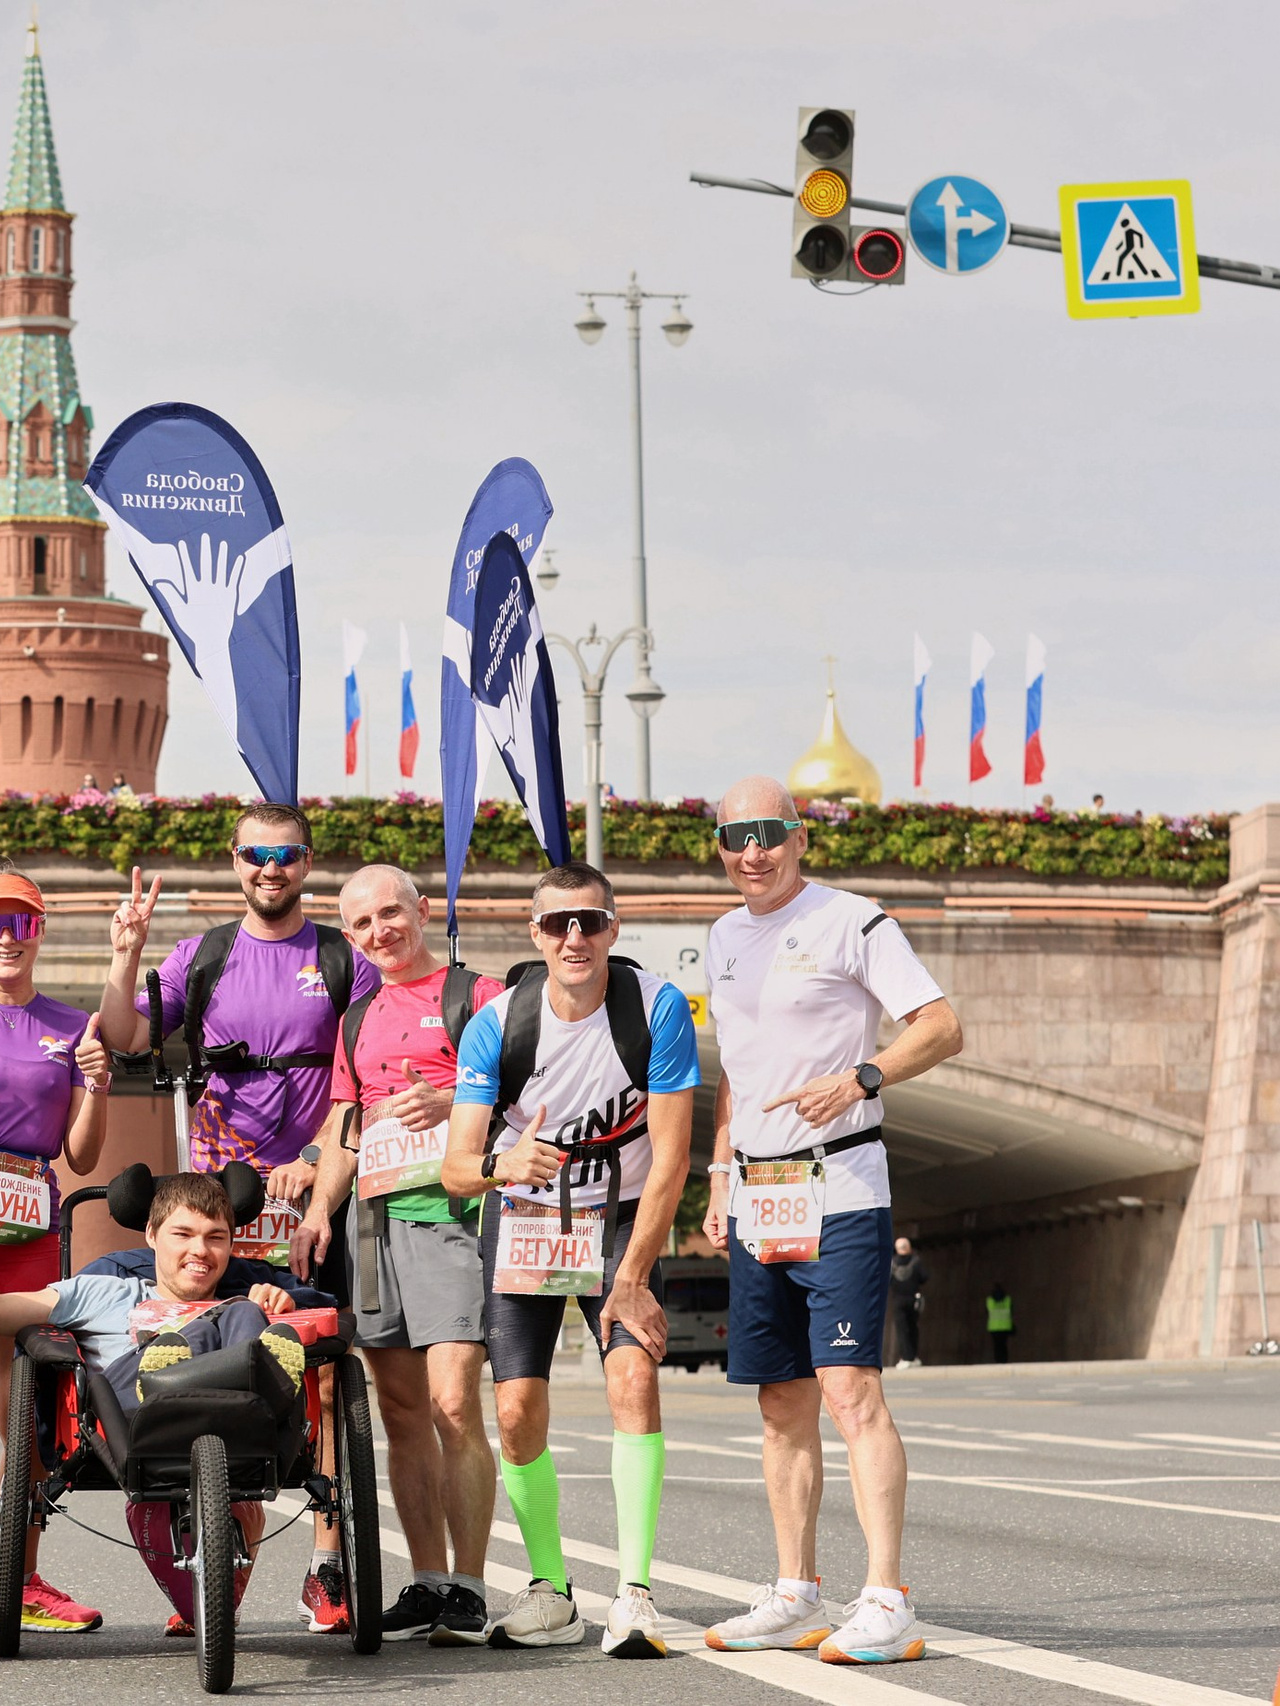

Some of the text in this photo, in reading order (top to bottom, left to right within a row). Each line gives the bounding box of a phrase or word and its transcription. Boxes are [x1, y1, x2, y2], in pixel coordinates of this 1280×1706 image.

[465, 522, 519, 570] Свда
[365, 1130, 442, 1171] БЕГУНА
[233, 1213, 299, 1240] ЕГУН
[512, 1223, 595, 1237] СОПРОВОЖЕНИЕ
[508, 1237, 594, 1268] БЕГУНА
[829, 1338, 859, 1347] JÖGEL
